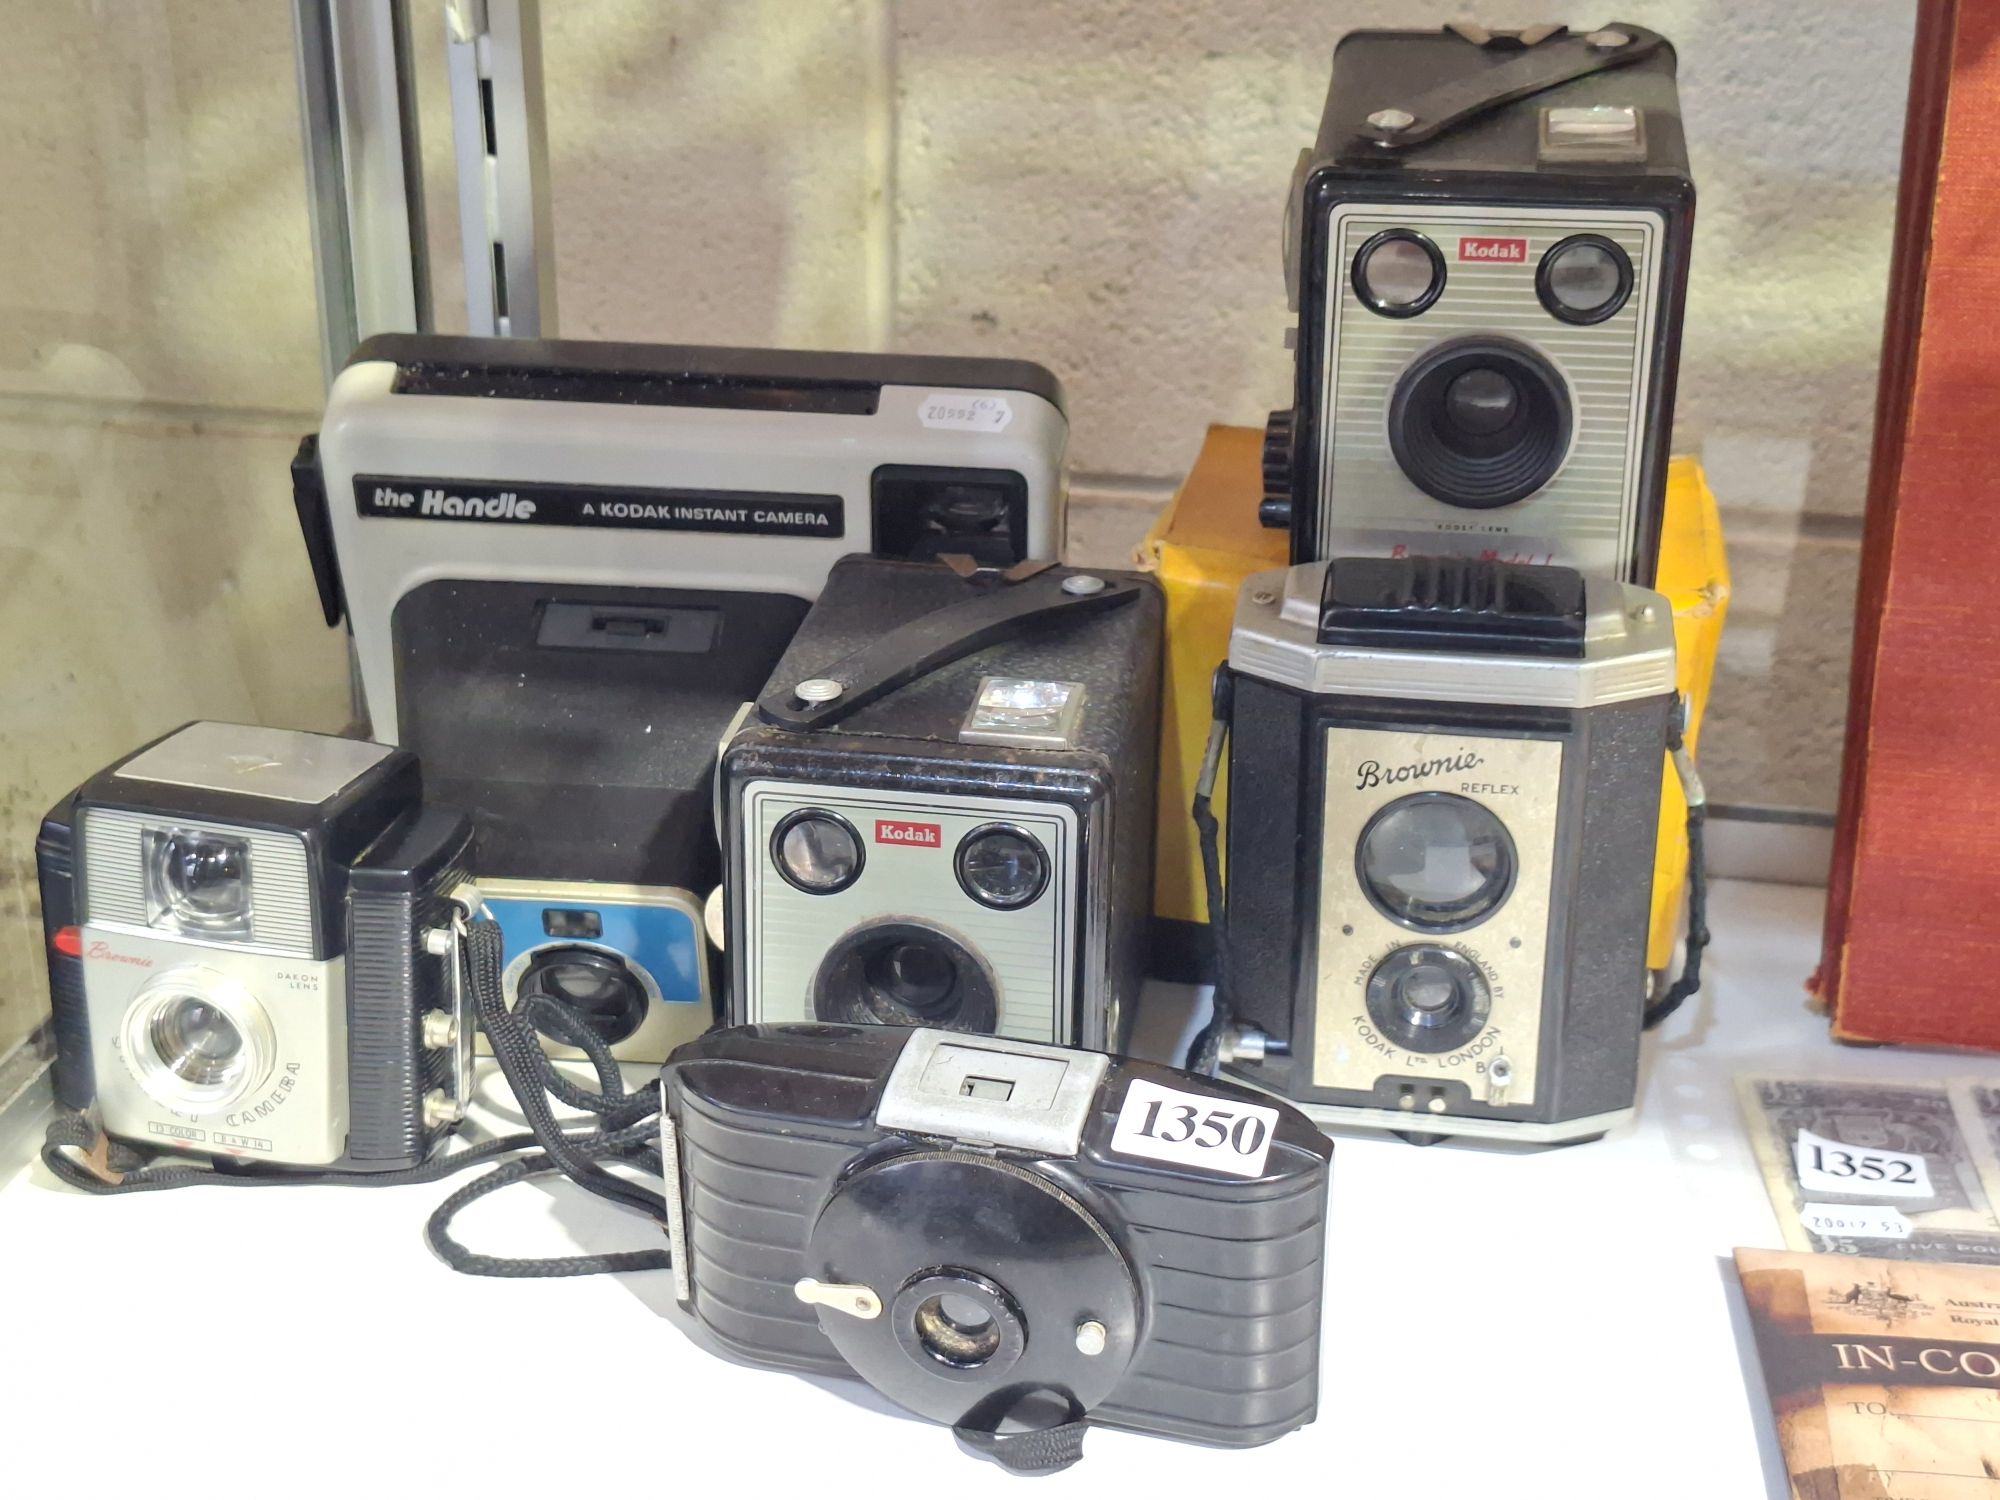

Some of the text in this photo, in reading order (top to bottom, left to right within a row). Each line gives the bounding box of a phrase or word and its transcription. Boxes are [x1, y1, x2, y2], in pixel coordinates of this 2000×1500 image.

[1464, 242, 1521, 259] Kodak
[374, 487, 537, 520] the Handle
[582, 502, 829, 526] A KODAK INSTANT CAMERA
[1355, 747, 1485, 791] Brownie
[1460, 782, 1520, 795] REFLEX
[880, 824, 936, 843] Kodak
[87, 941, 154, 968] Brownie
[276, 971, 319, 982] DAKON
[1353, 940, 1505, 999] MADE IN ENGLAND BY
[289, 982, 319, 991] LENS
[1353, 1015, 1398, 1060] KODAK
[1438, 1026, 1502, 1069] LONDON
[226, 1062, 301, 1127] CAMERA
[1132, 1100, 1266, 1156] 1350
[1808, 1144, 1918, 1184] 1352
[1949, 1314, 1999, 1327] Royal
[1831, 1343, 2000, 1378] IN-CO
[1847, 1401, 1887, 1415] TO
